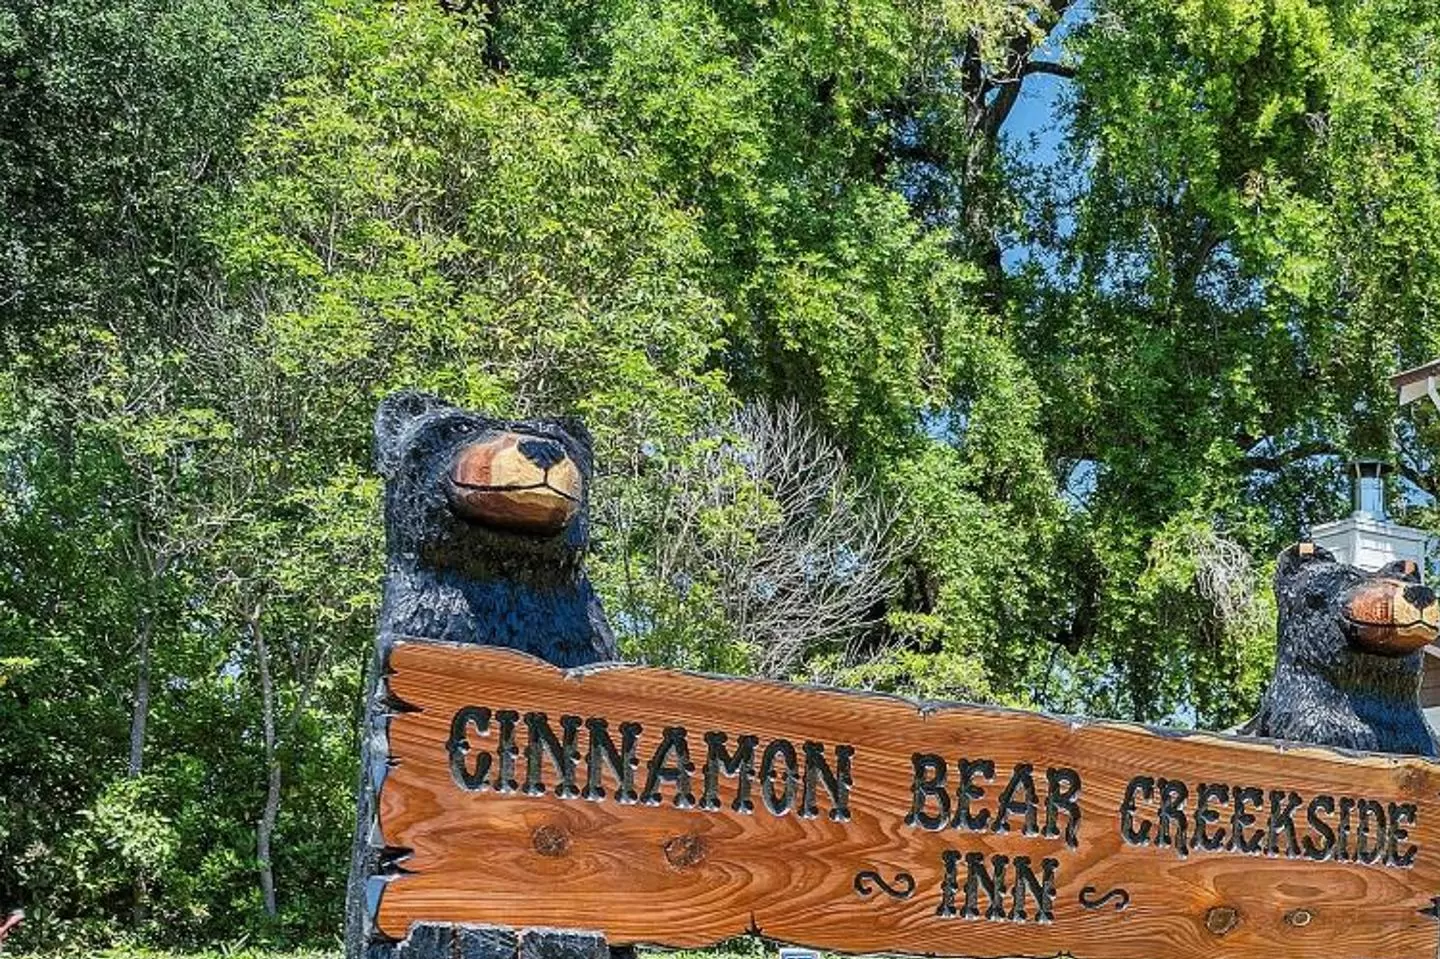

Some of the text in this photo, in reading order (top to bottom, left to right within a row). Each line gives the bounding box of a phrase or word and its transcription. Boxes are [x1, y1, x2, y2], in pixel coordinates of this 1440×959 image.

[446, 705, 1418, 868] CINNAMON BEAR CREEKSIDE
[935, 849, 1061, 924] INN
